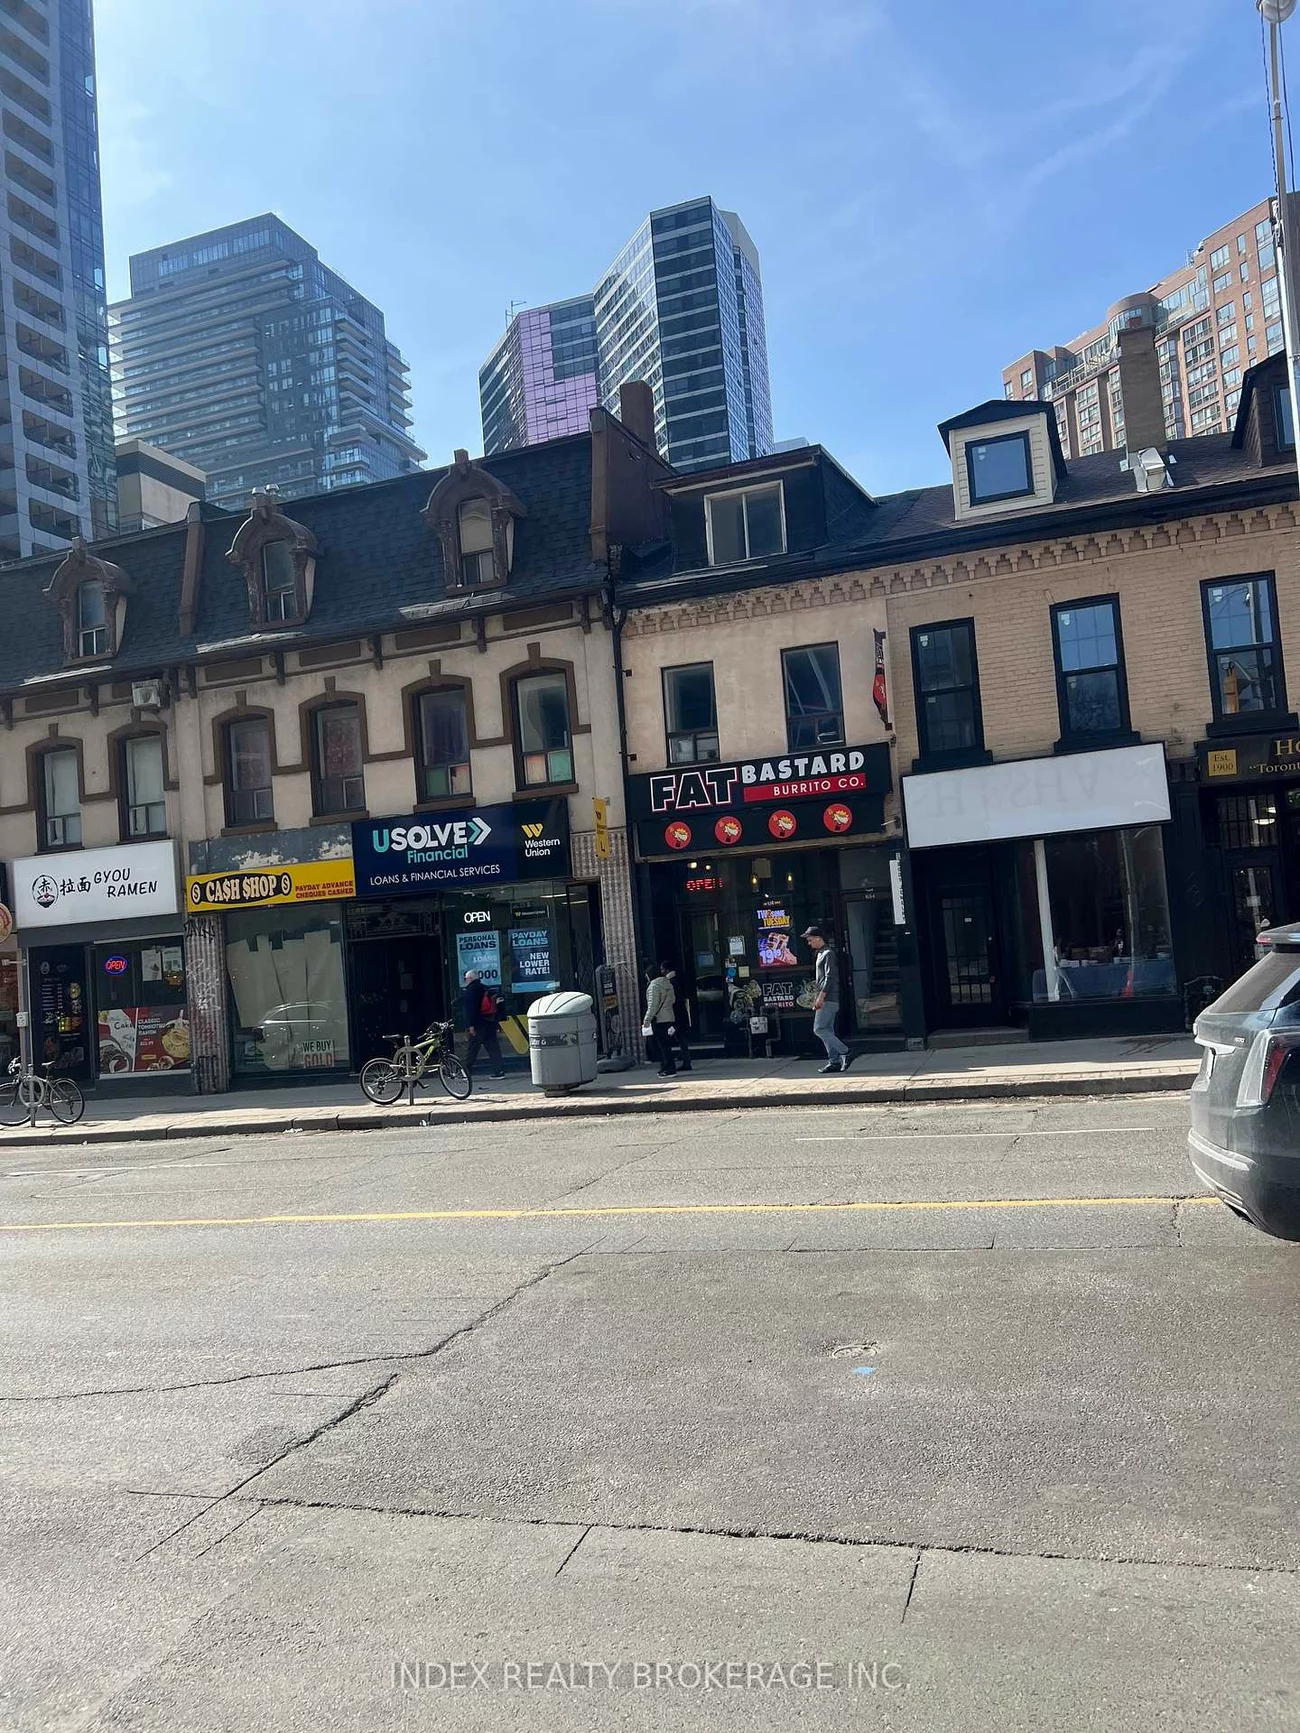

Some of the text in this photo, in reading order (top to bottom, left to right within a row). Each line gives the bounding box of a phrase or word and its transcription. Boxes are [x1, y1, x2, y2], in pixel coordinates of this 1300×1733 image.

[1213, 762, 1234, 772] 1900
[649, 751, 865, 812] FAT BASTARD
[773, 776, 865, 797] BURRITO CO.
[373, 821, 467, 853] USOLVE
[524, 838, 561, 849] Western
[407, 845, 468, 864] Financial
[525, 848, 551, 858] Union
[94, 868, 131, 884] GYOU
[370, 864, 501, 886] LOANS & FINANCIAL SERVICES
[60, 876, 92, 896] 拉面
[107, 881, 158, 898] RAMEN
[295, 880, 353, 892] PAYDAY ADVANCE
[686, 878, 723, 891] OPEN
[295, 887, 353, 899] CHEQUES CASHED
[464, 911, 491, 923] OPEN
[459, 934, 496, 943] PERSONAL
[512, 930, 548, 940] PAYDAY
[460, 941, 497, 951] LOANS
[512, 937, 549, 947] LOANS
[530, 951, 550, 960] NEW
[107, 959, 126, 970] OPEN
[519, 959, 550, 968] LOWER
[525, 966, 550, 975] RATE!
[763, 982, 793, 996] FAT
[302, 1040, 331, 1052] WE BUY
[304, 1053, 333, 1067] GOLD
